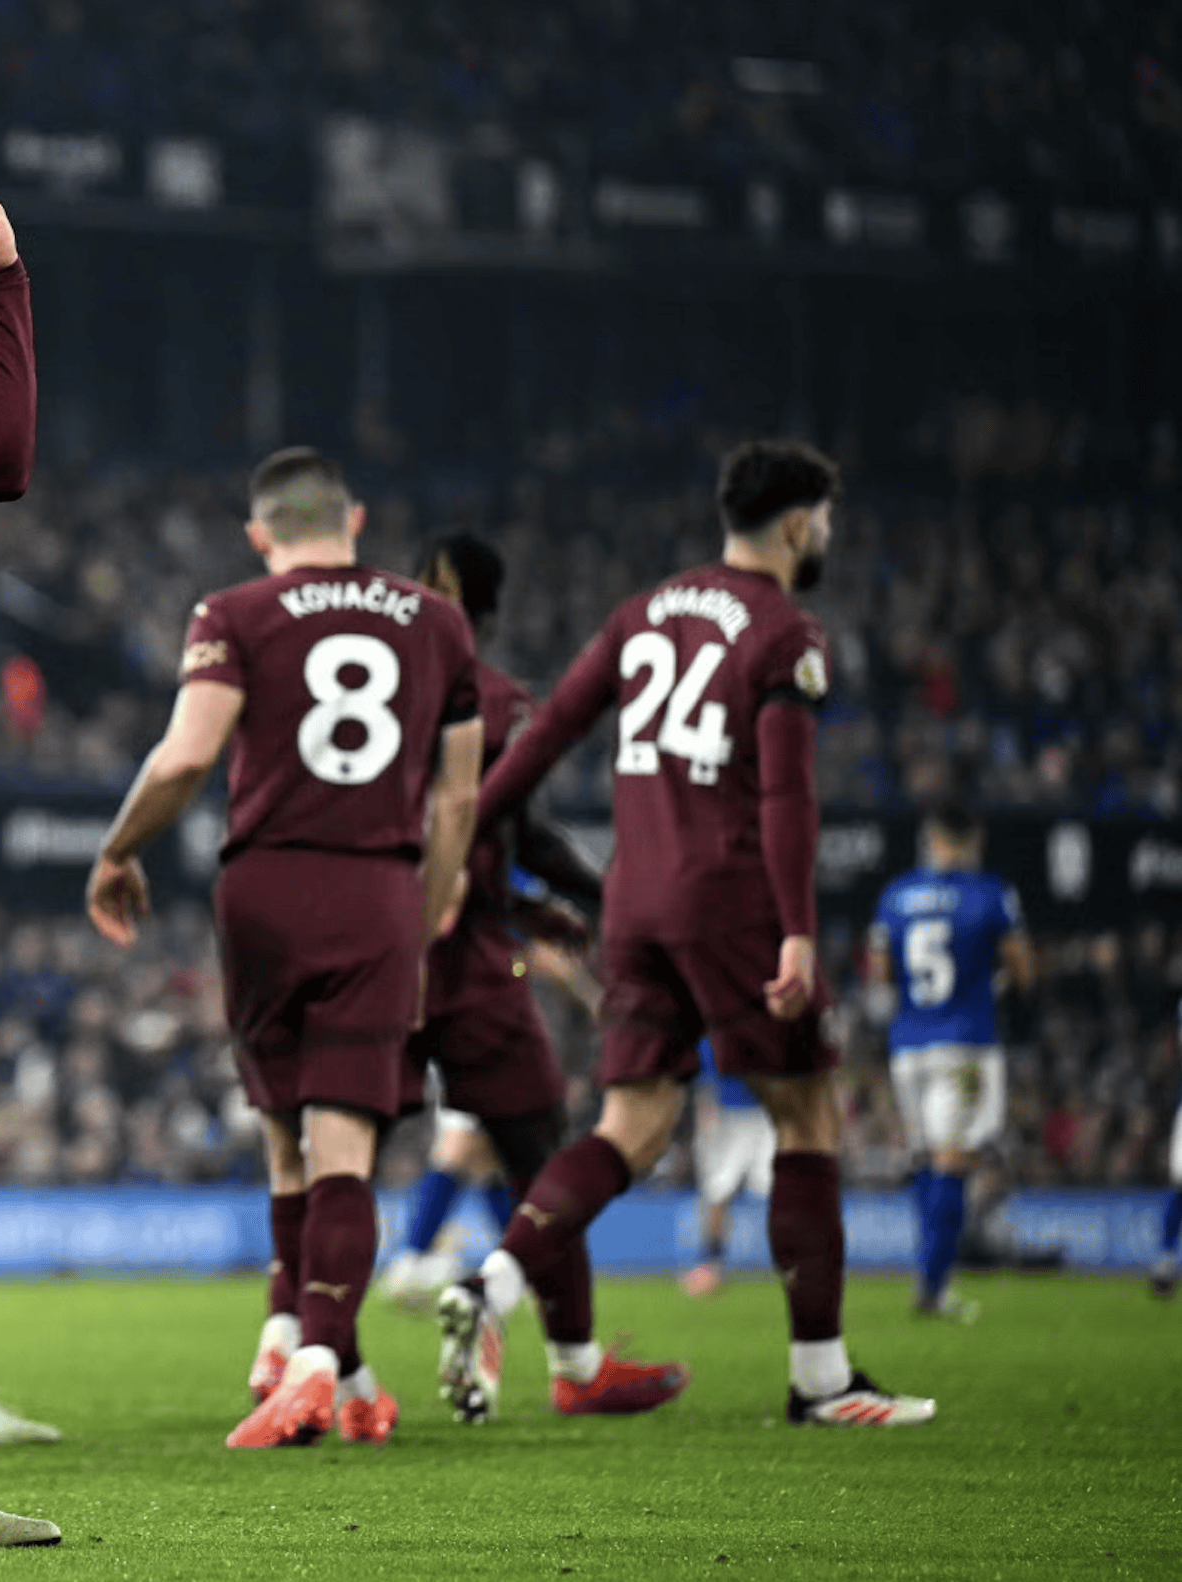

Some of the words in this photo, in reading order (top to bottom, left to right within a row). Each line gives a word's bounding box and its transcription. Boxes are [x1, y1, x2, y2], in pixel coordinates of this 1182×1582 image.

[298, 633, 401, 785] 8
[616, 631, 734, 785] 24
[904, 917, 956, 1006] 5
